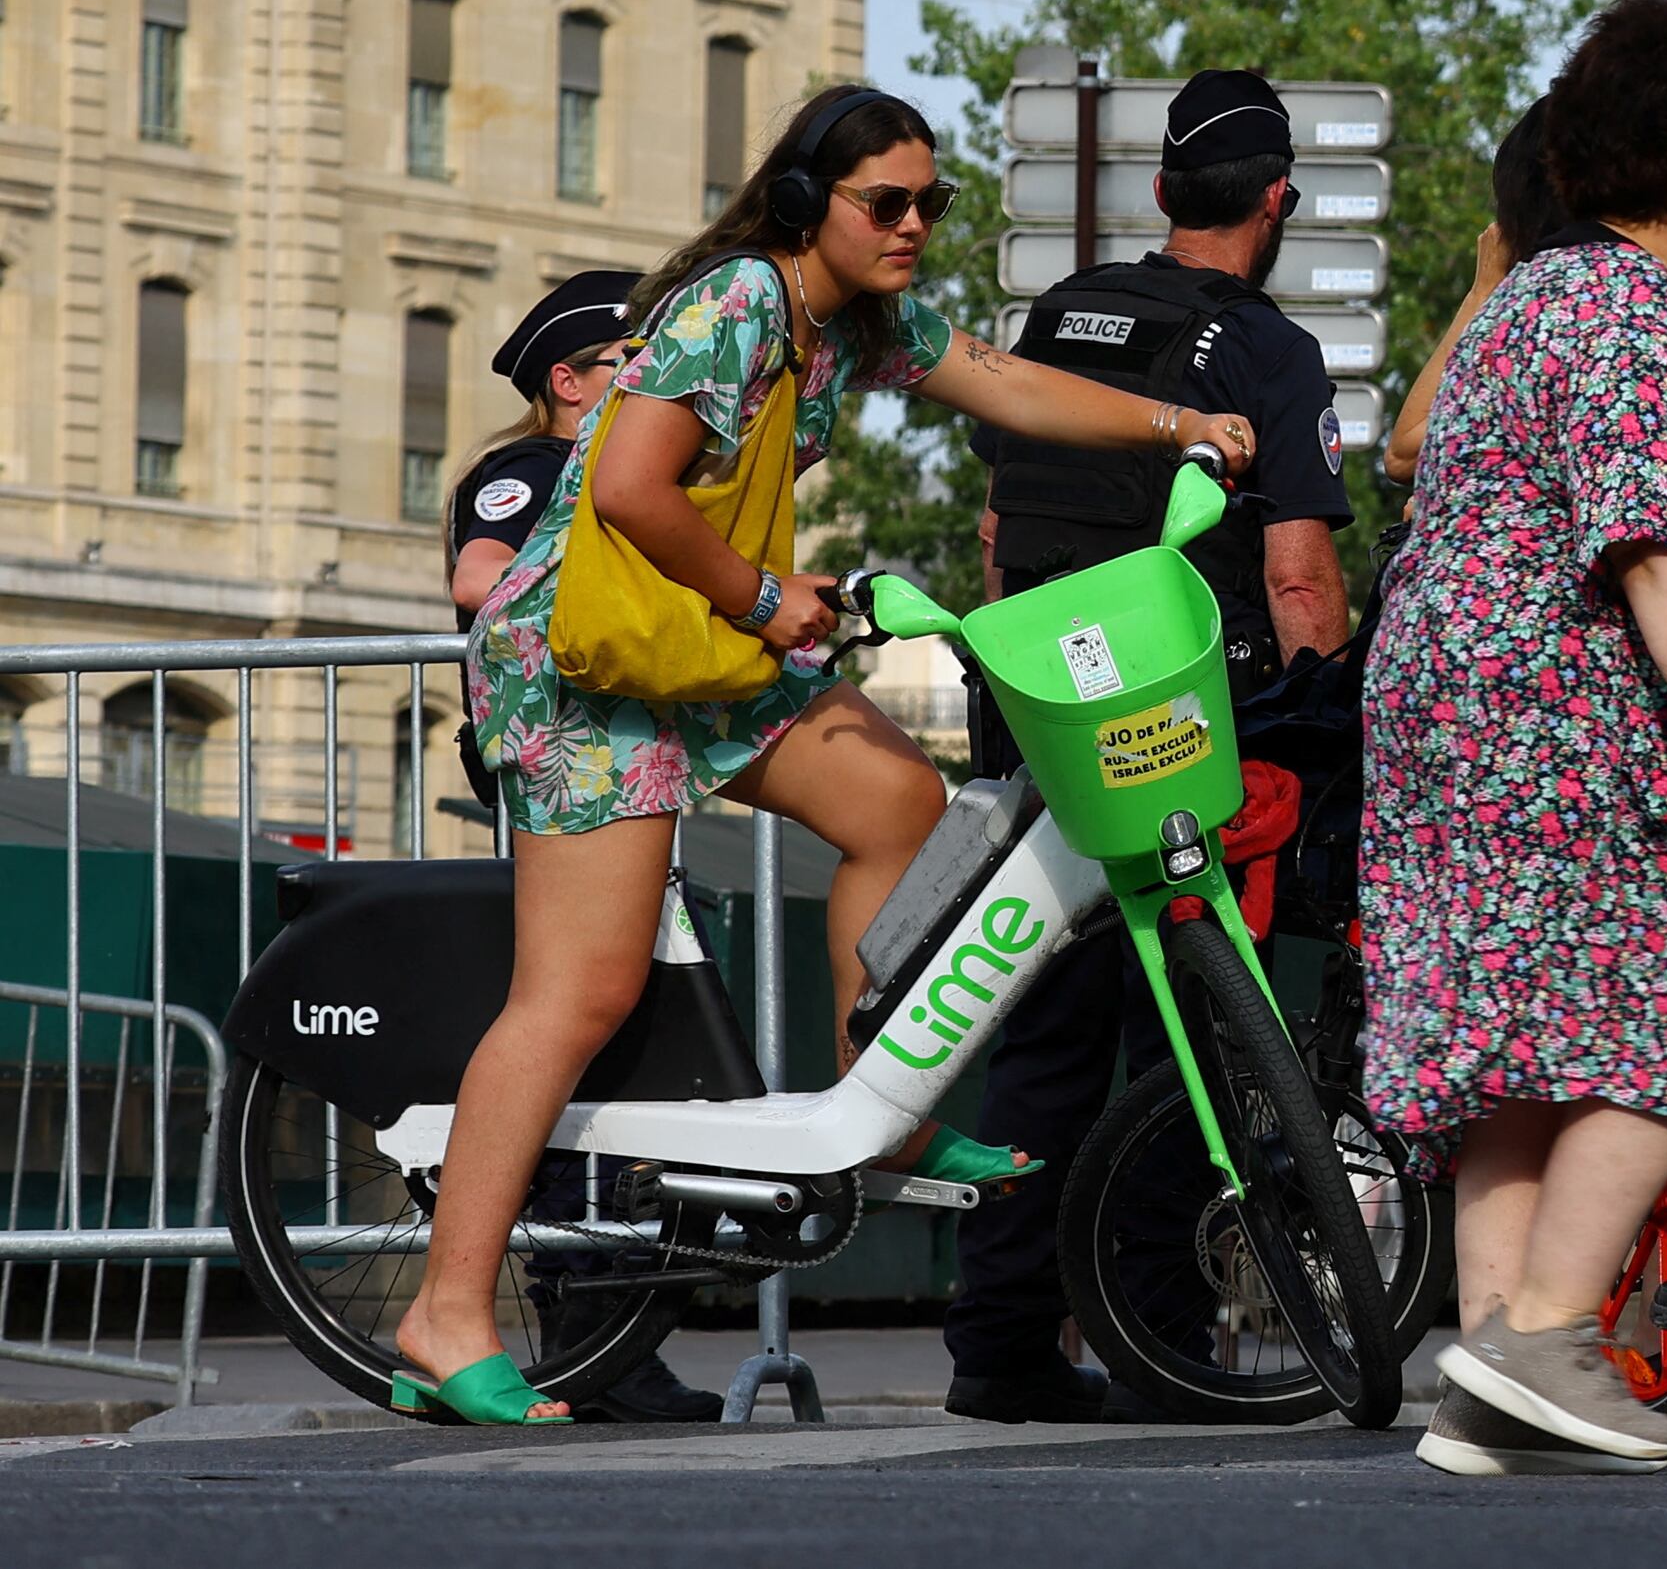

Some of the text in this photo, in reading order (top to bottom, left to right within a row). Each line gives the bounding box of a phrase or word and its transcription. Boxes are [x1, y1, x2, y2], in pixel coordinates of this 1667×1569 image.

[1058, 317, 1131, 339] POLICE
[1105, 725, 1155, 747] JO DE
[1151, 730, 1196, 756] EXCLUE
[1112, 761, 1157, 779] ISRAEL
[1158, 743, 1196, 768] EXCLU
[876, 896, 1045, 1070] Lime
[293, 999, 379, 1036] Lime
